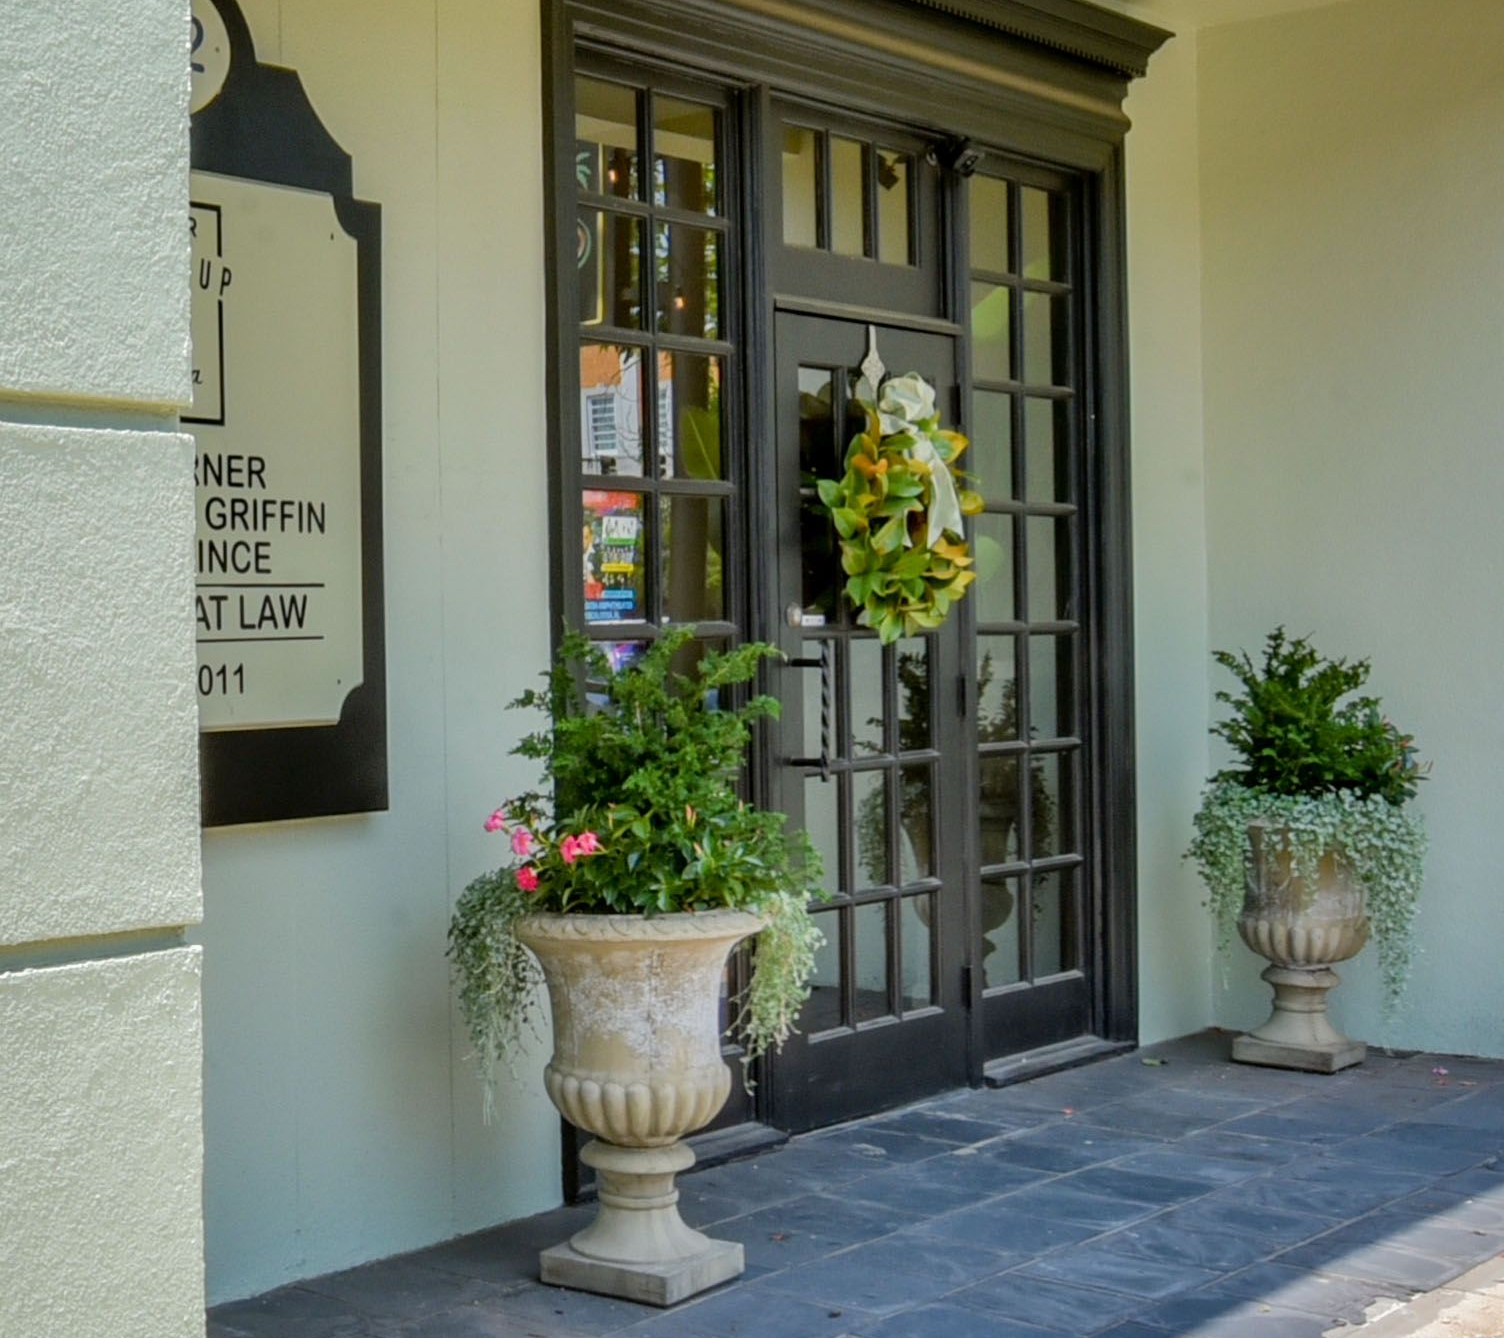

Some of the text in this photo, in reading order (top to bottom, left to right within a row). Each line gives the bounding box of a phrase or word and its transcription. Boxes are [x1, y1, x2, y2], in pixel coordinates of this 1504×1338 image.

[205, 497, 325, 534] GRIFFIN
[196, 593, 308, 631] AT LAW
